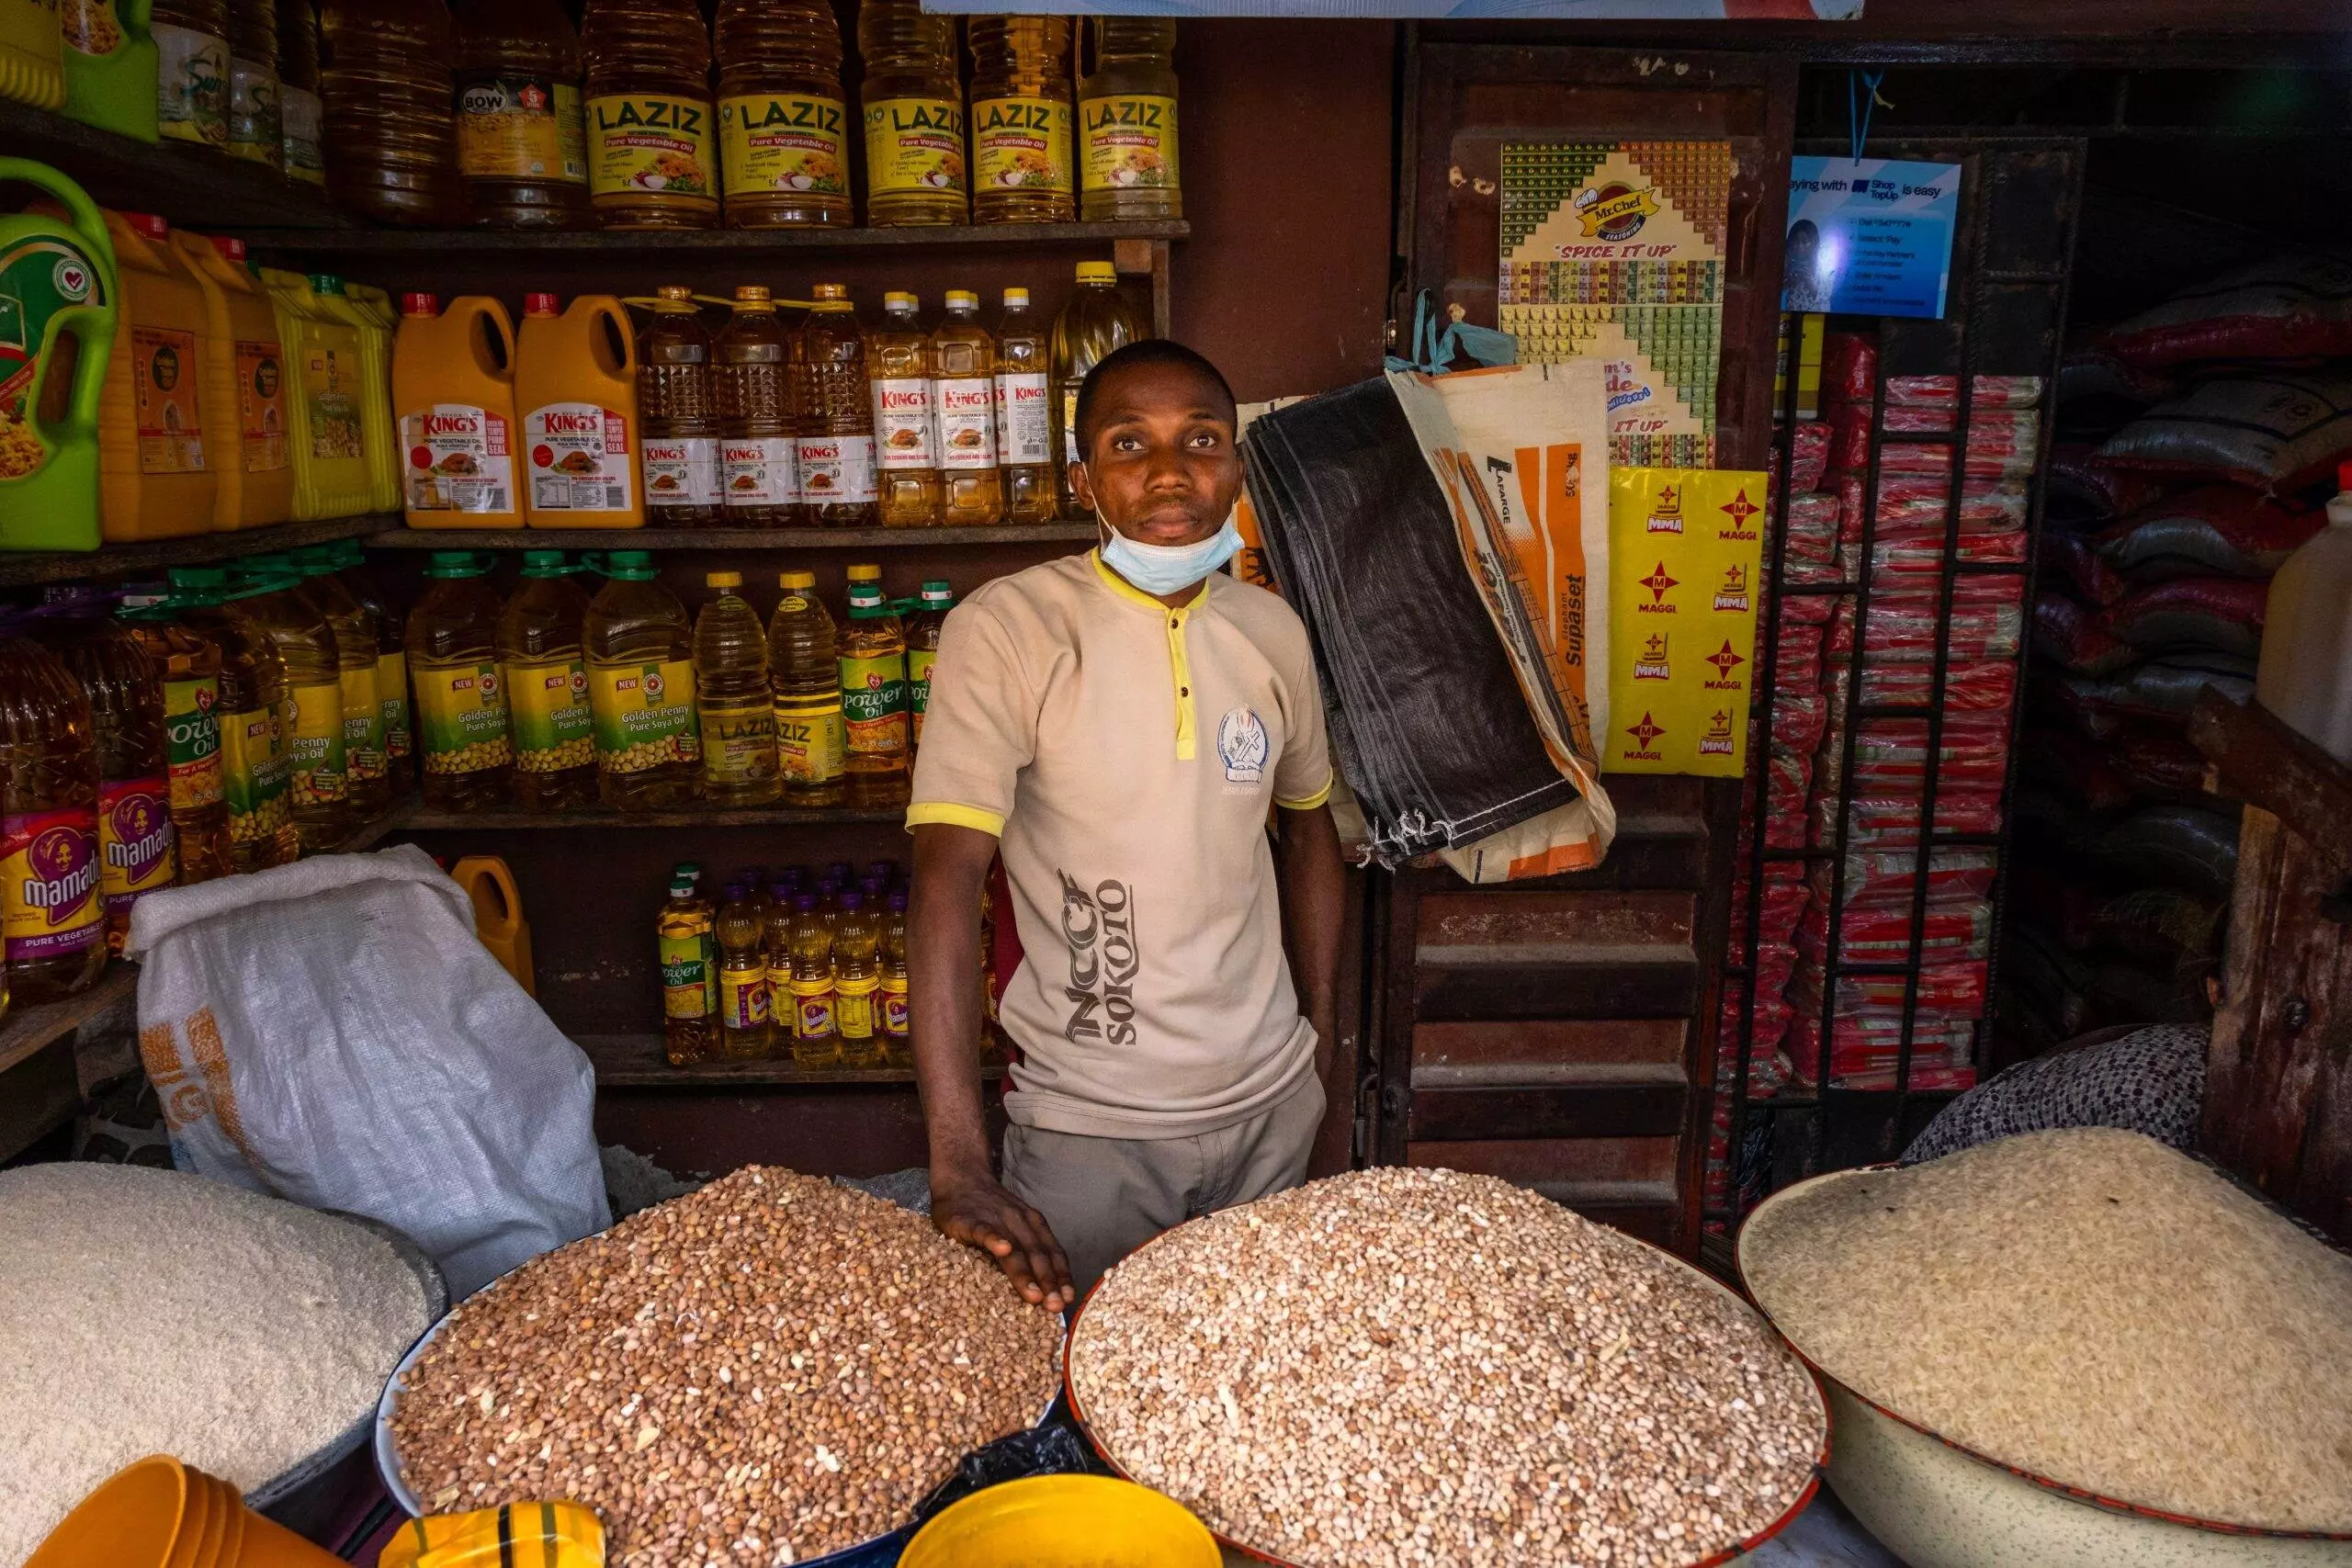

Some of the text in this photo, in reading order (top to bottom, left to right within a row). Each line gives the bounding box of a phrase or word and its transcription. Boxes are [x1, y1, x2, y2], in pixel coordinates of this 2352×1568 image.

[465, 96, 503, 108] BOW
[597, 101, 701, 136] LAZIZ
[741, 101, 841, 136] LAZIZ
[977, 104, 1050, 133] LAZIZ
[1087, 102, 1161, 132] LAZIZ
[606, 137, 694, 152] Pure Vegetable Oil
[751, 137, 835, 152] Pure Vegetable Oil
[900, 139, 920, 147] Pure
[995, 139, 1033, 147] Vegetable
[1034, 141, 1045, 150] Oil
[1148, 139, 1158, 147] Oil
[1822, 179, 1847, 191] with
[1871, 179, 1899, 200] Shop TopUp
[1902, 186, 1941, 198] is easy
[1605, 221, 1641, 241] SEASONING
[1621, 243, 1645, 258] IT
[882, 390, 926, 409] KING'S
[945, 390, 989, 409] KING'S
[1015, 387, 1046, 400] KING'S
[423, 414, 479, 434] KING'S
[545, 413, 597, 434] KING'S
[1614, 419, 1638, 433] IT
[488, 436, 505, 445] PROOF
[488, 445, 507, 455] SEAL
[607, 443, 625, 453] SEAL
[647, 447, 685, 461] KING'S
[725, 447, 764, 462] KING'S
[801, 446, 839, 460] KING'S
[1496, 467, 1510, 524] LAFARGE
[1649, 517, 1681, 531] MMA
[1719, 531, 1757, 540] MAGGI
[1638, 604, 1676, 613] MAGGI
[1715, 595, 1747, 609] MMA
[1566, 572, 1582, 667] Supaset
[1635, 664, 1668, 678] MMA
[455, 680, 472, 689] NEW
[548, 679, 564, 687] NEW
[618, 680, 637, 689] NEW
[1704, 681, 1741, 690] MAGGI
[844, 685, 903, 709] Power
[384, 699, 401, 710] nny
[865, 705, 883, 717] Oil
[386, 709, 397, 718] Oil
[458, 710, 492, 723] Golden
[551, 706, 583, 721] Golden
[622, 705, 690, 723] Golden Penny
[345, 717, 372, 728] enny
[466, 718, 506, 732] Pure Soya
[558, 717, 594, 730] Pure Soy
[630, 714, 685, 732] Pure Soya Oil
[353, 728, 367, 739] Oil
[193, 735, 216, 755] Oil
[292, 737, 331, 749] Penny
[1702, 739, 1733, 752] MMA
[310, 747, 324, 759] Oil
[1623, 750, 1661, 761] MAGGI
[107, 815, 175, 868] mamado
[25, 849, 102, 908] mamado
[109, 894, 134, 905] PURE
[26, 921, 100, 947] PURE VEGETABLE
[1095, 878, 1141, 1045] SOKOTO
[662, 964, 702, 977] ower
[671, 976, 684, 985] Oil
